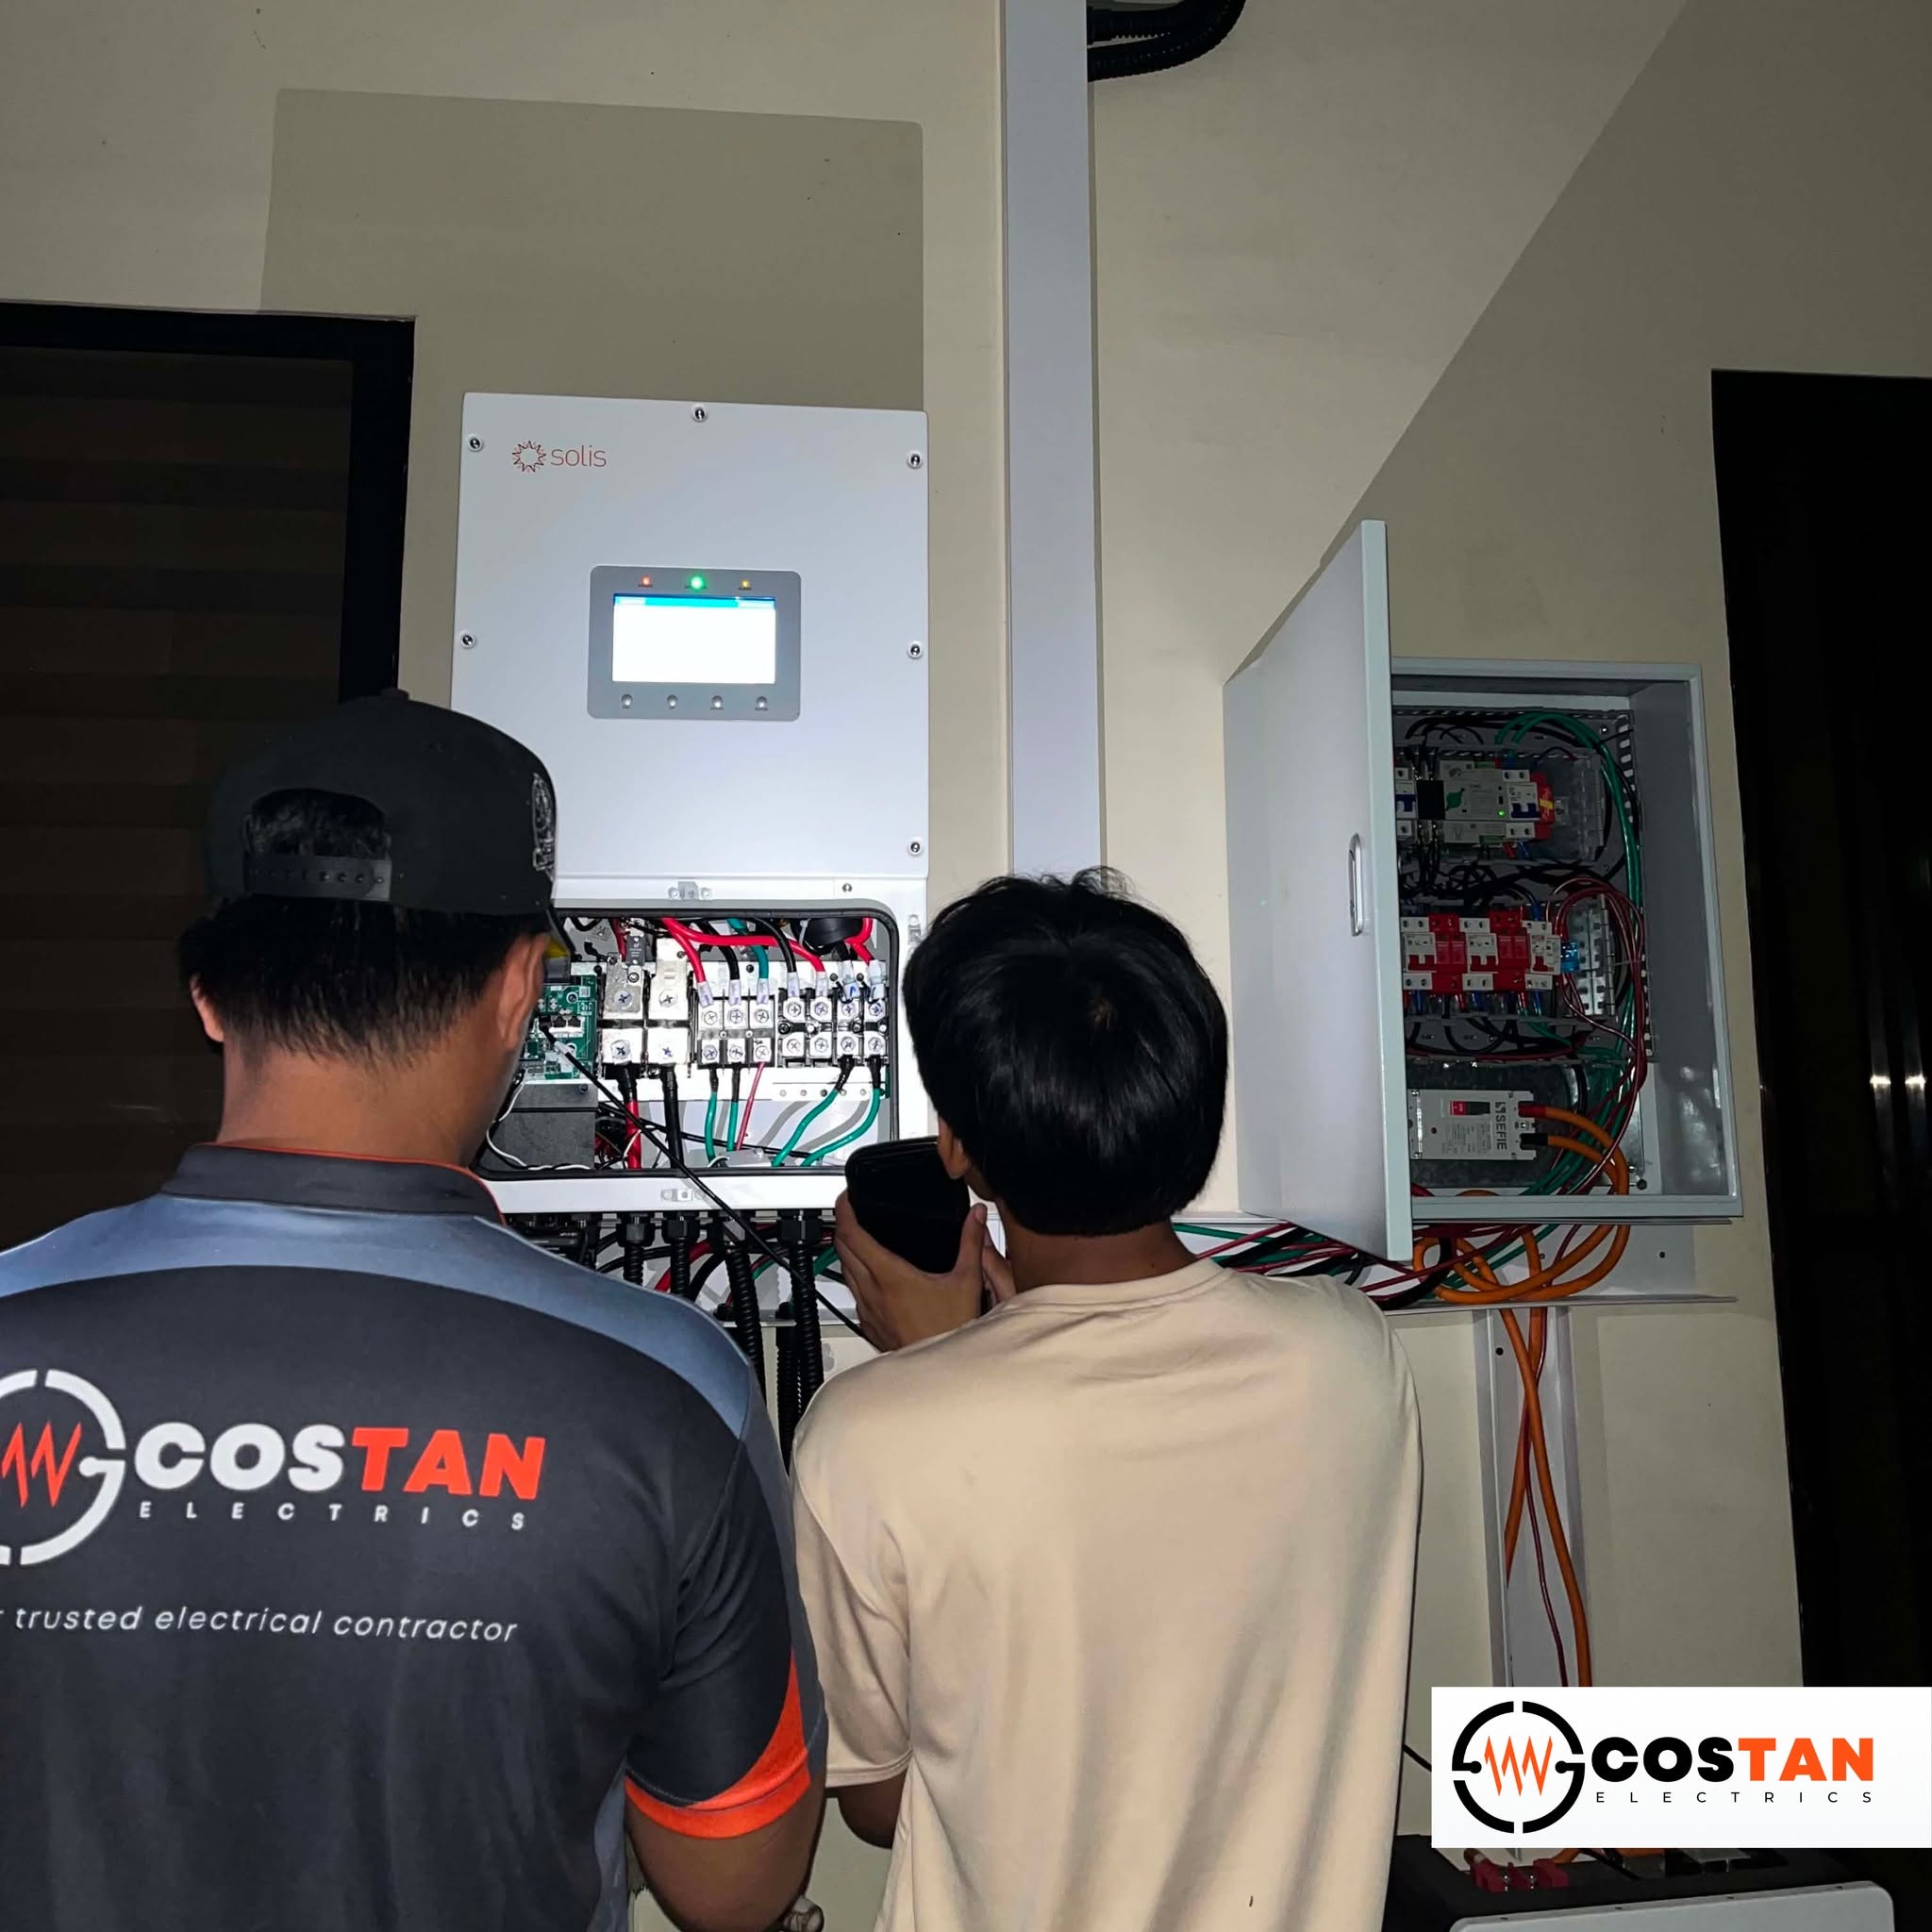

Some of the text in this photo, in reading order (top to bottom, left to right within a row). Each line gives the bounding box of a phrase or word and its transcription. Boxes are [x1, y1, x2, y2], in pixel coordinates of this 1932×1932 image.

[550, 444, 608, 468] solis
[135, 1423, 545, 1500] COSTAN
[139, 1501, 525, 1530] ELECTRICS
[15, 1606, 142, 1631] trusted
[154, 1606, 323, 1634] electrical
[333, 1616, 518, 1642] contractor
